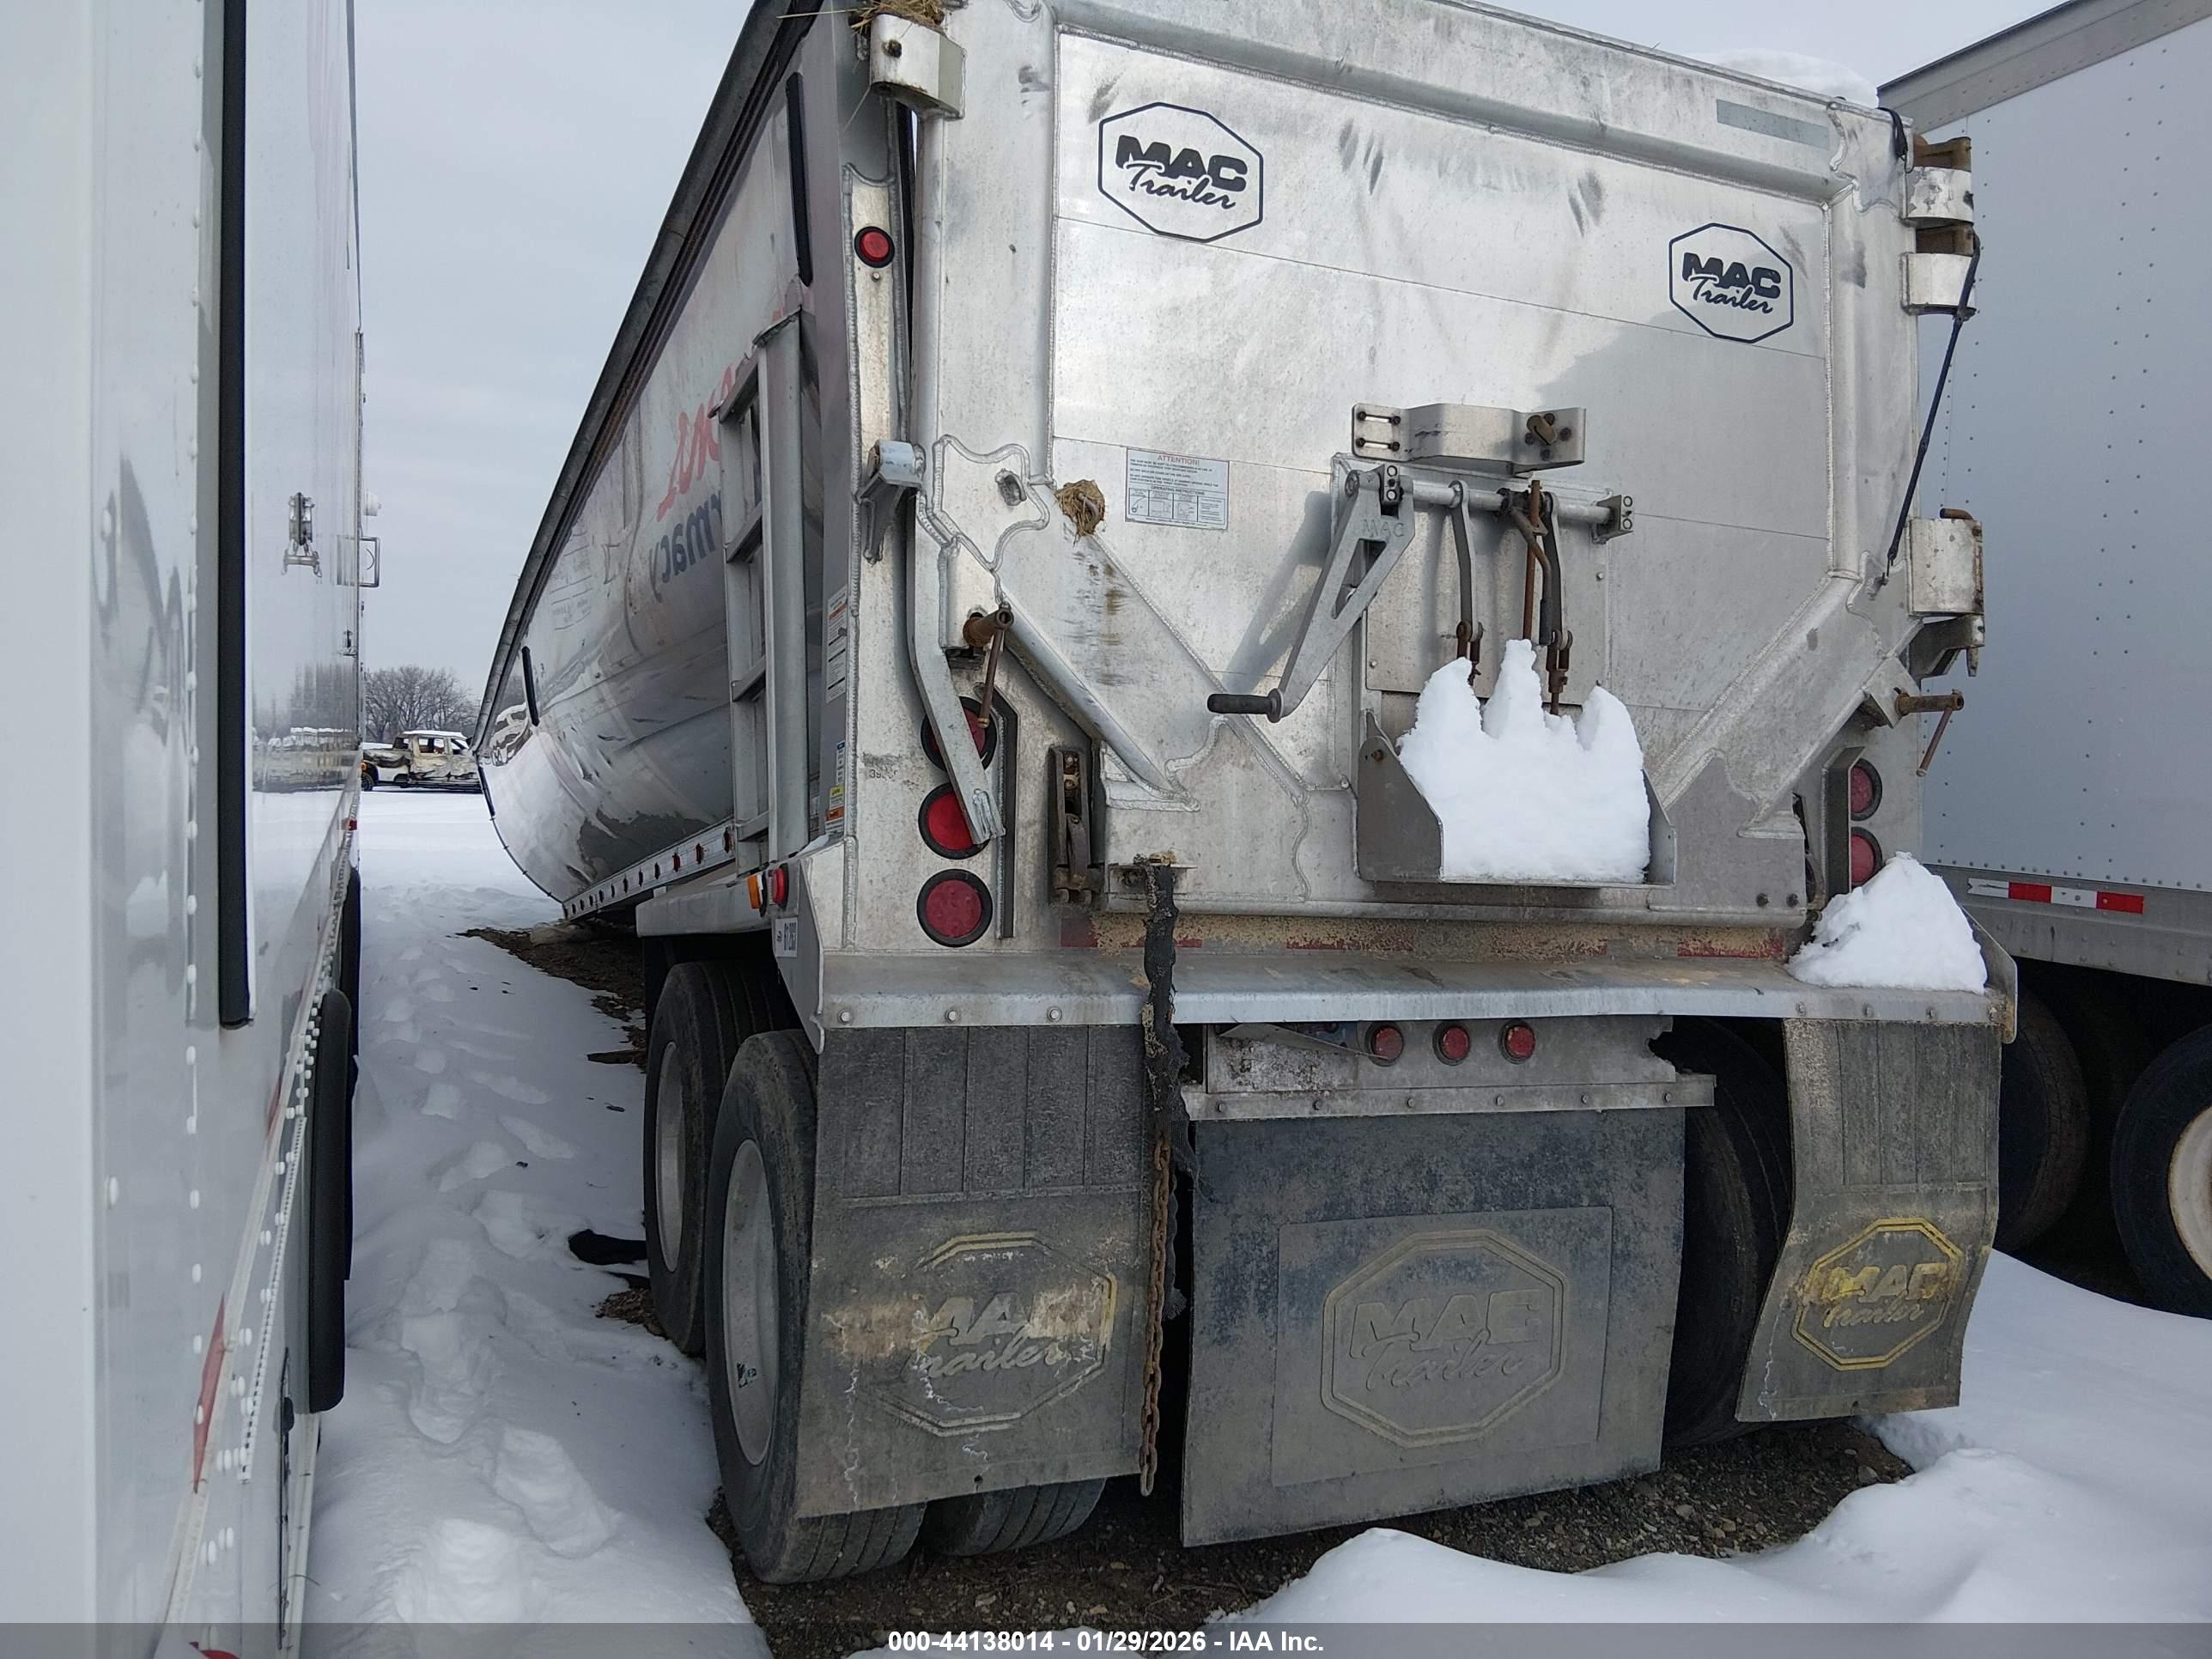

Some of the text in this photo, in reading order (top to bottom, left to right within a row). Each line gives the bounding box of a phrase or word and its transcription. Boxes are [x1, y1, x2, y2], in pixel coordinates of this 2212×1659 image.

[1115, 134, 1248, 192] MAC
[1125, 160, 1237, 210] Trailer
[1681, 252, 1782, 299] MAC
[1689, 276, 1773, 314] Trailer
[1157, 454, 1200, 465] ATTENTION!
